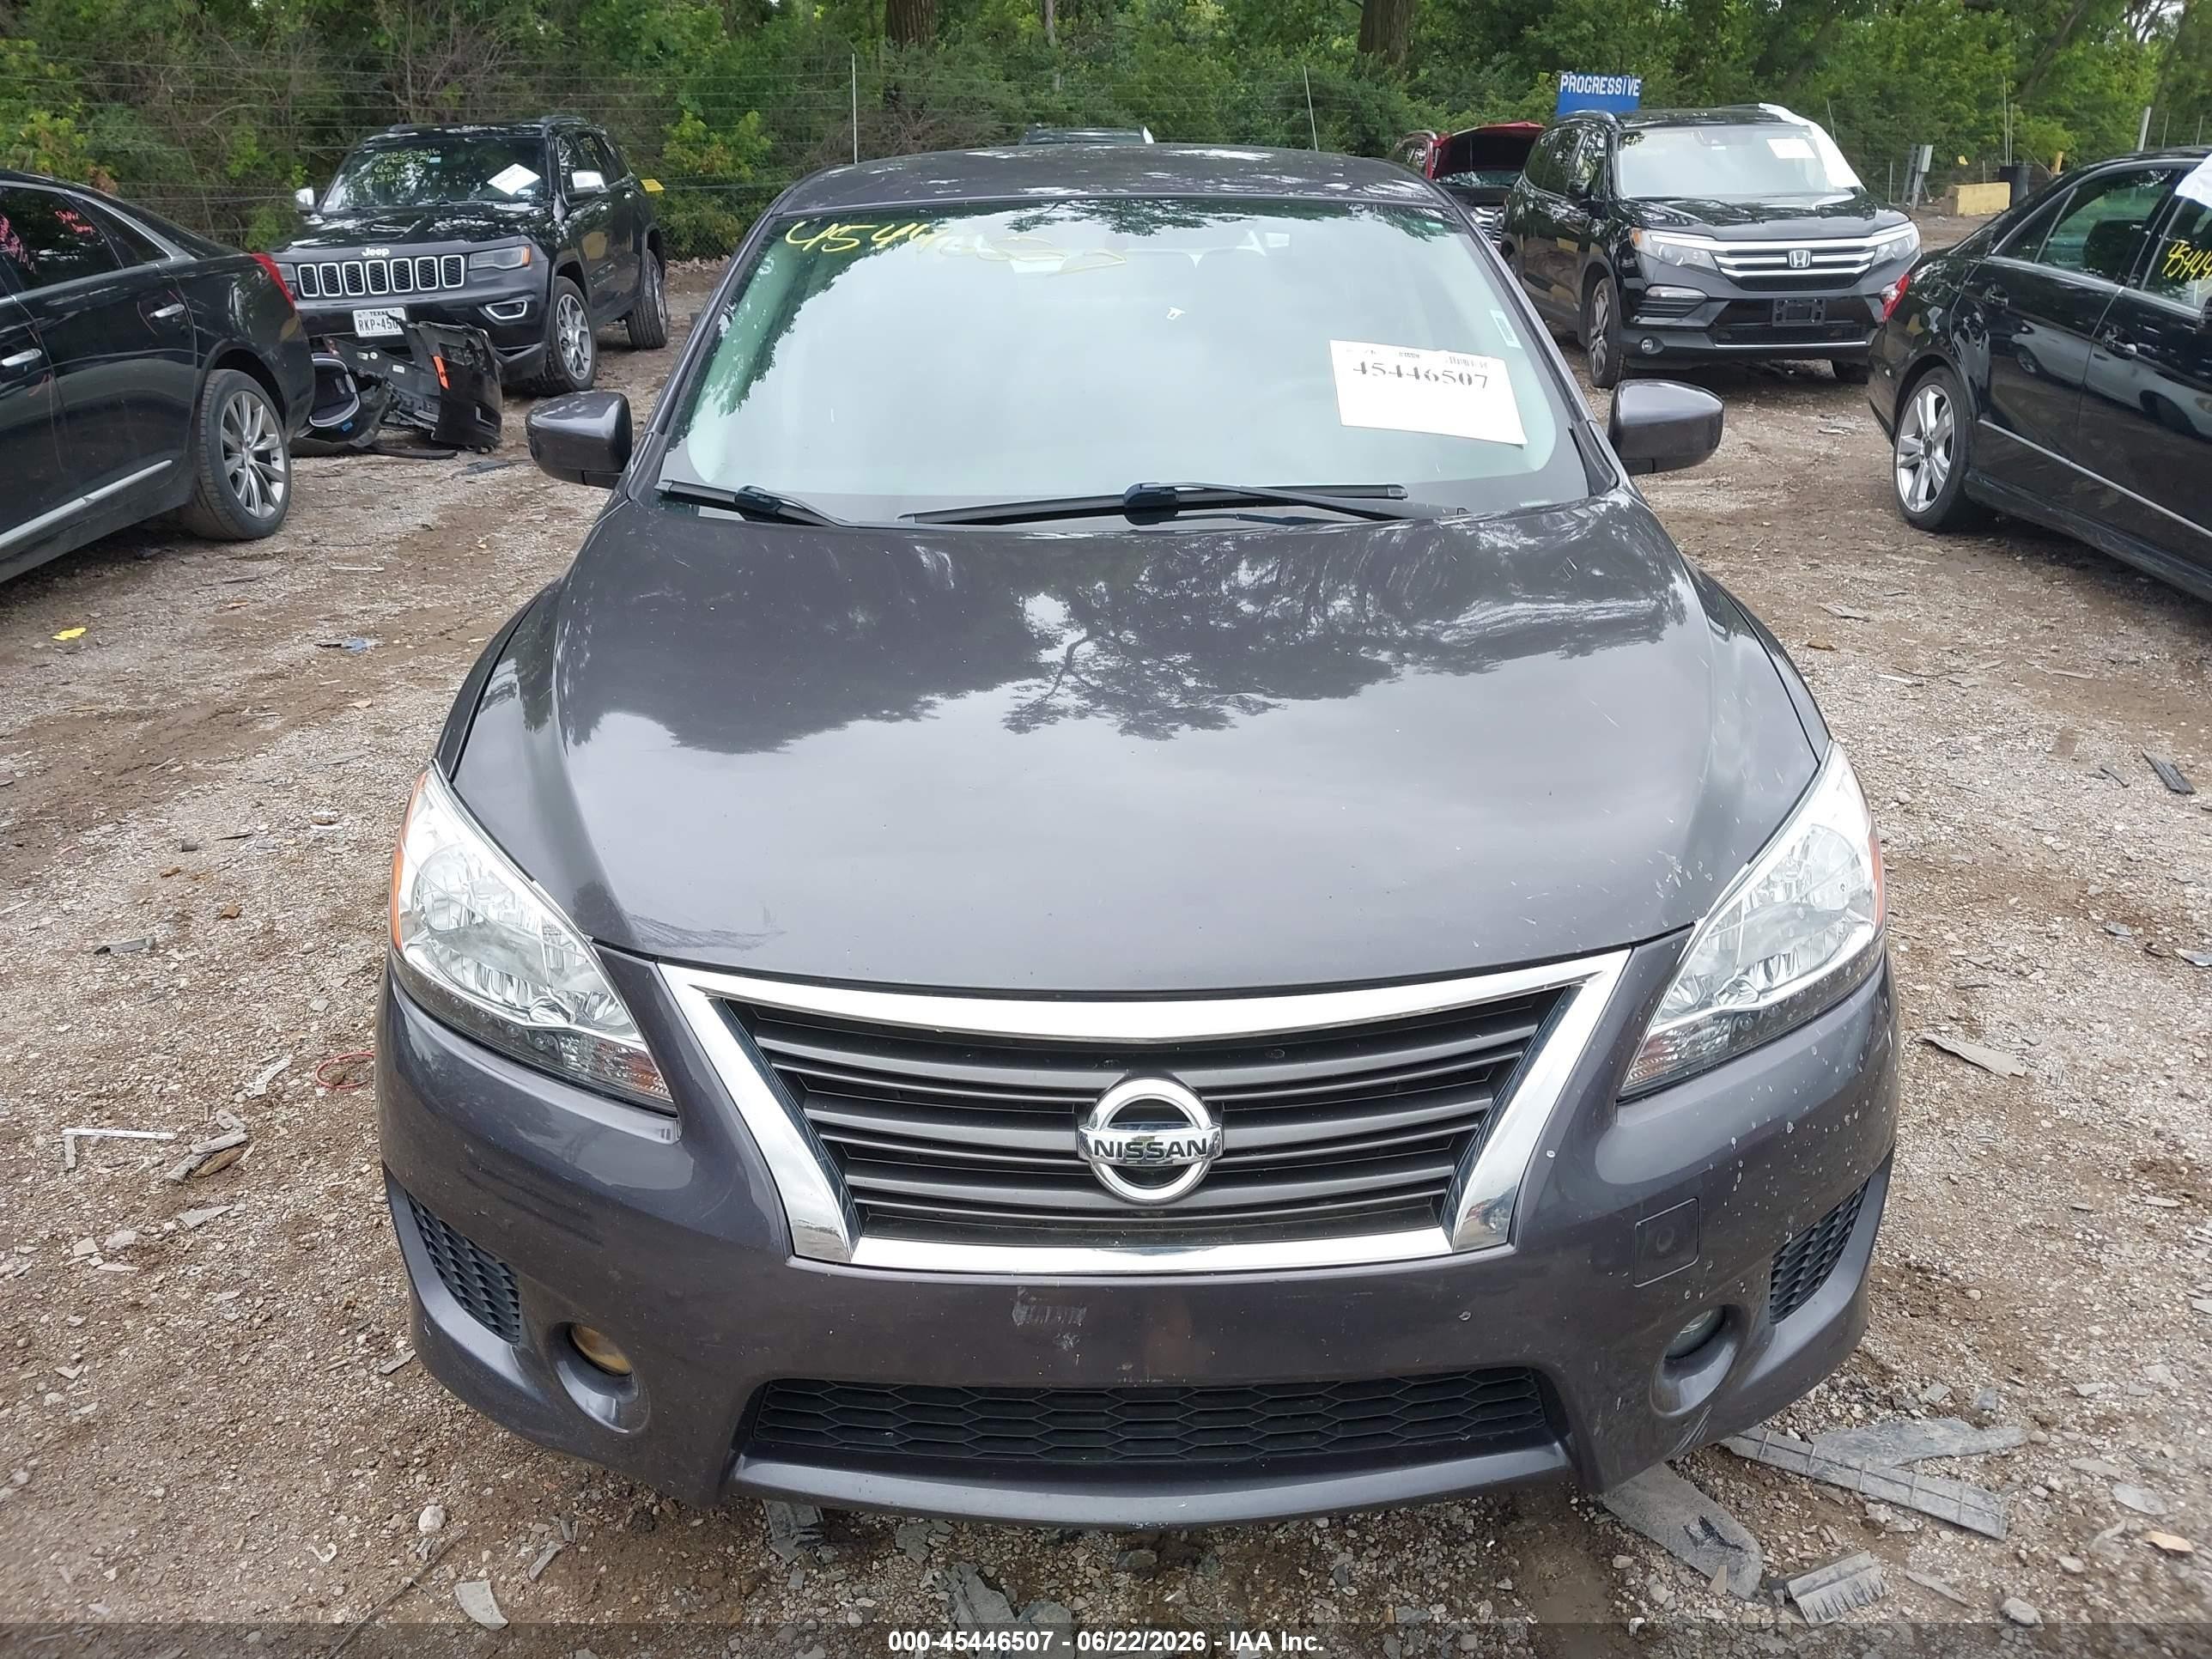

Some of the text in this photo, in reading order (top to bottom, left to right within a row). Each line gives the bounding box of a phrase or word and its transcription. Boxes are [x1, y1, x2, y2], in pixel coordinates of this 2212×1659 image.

[1560, 75, 1642, 96] PROGRESSIVE
[362, 247, 390, 257] Jeep
[1353, 362, 1487, 388] 45446507
[1094, 1138, 1207, 1159] NISSAN
